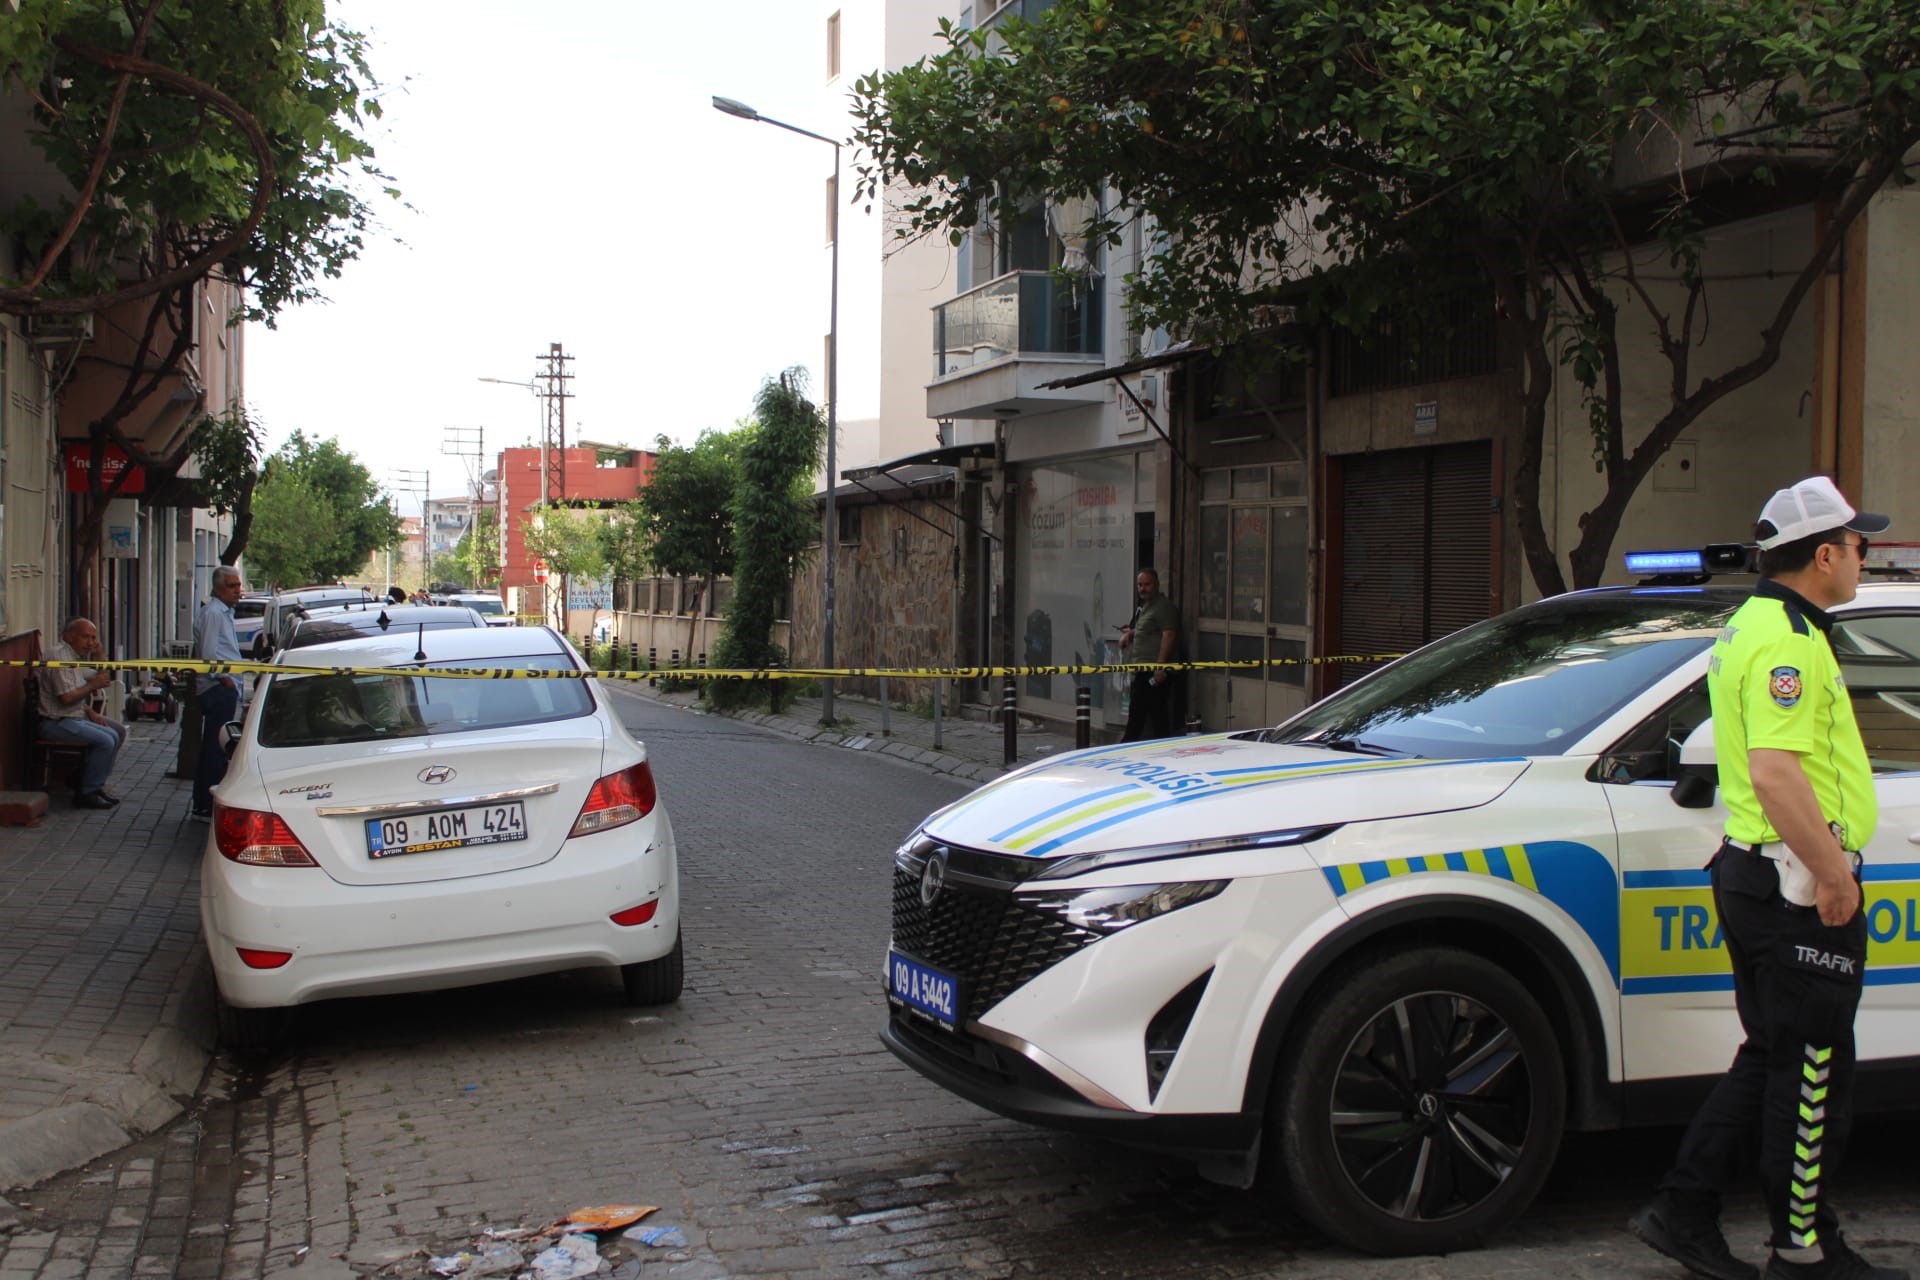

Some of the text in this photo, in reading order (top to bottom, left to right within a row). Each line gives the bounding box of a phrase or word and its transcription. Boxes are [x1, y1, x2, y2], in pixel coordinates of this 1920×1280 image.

[1078, 485, 1116, 507] TOSHIBA
[279, 783, 334, 795] ACCENT
[307, 791, 333, 801] blue
[383, 806, 520, 845] 09 AOM 424
[372, 838, 382, 846] TR
[407, 839, 462, 853] DESTAN
[895, 961, 909, 995] 09
[911, 968, 919, 1001] A
[922, 972, 951, 1016] 5442
